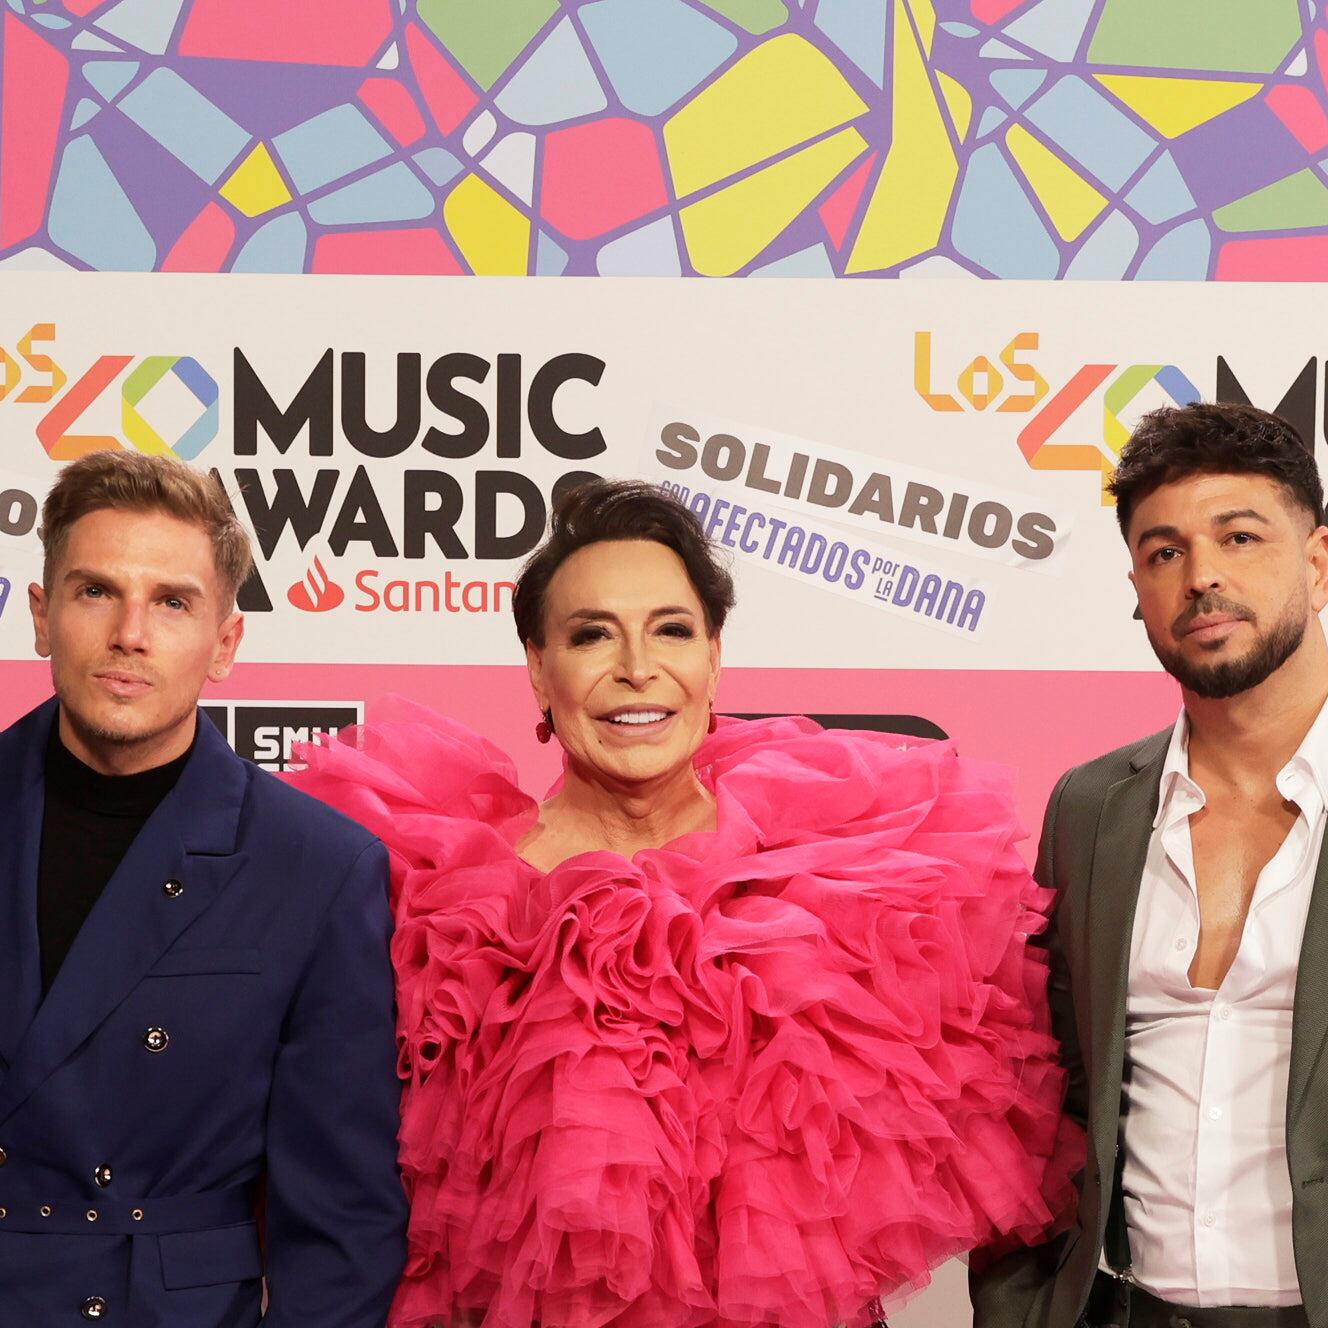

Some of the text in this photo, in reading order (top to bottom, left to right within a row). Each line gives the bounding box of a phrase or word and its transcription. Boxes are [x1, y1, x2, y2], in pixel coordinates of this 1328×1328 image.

[233, 346, 607, 460] MUSIC
[655, 422, 1056, 559] SOLIDARIOS
[355, 570, 515, 613] Santan
[689, 493, 871, 590] AFECTADOS
[876, 578, 891, 597] LA
[894, 565, 986, 631] DANA
